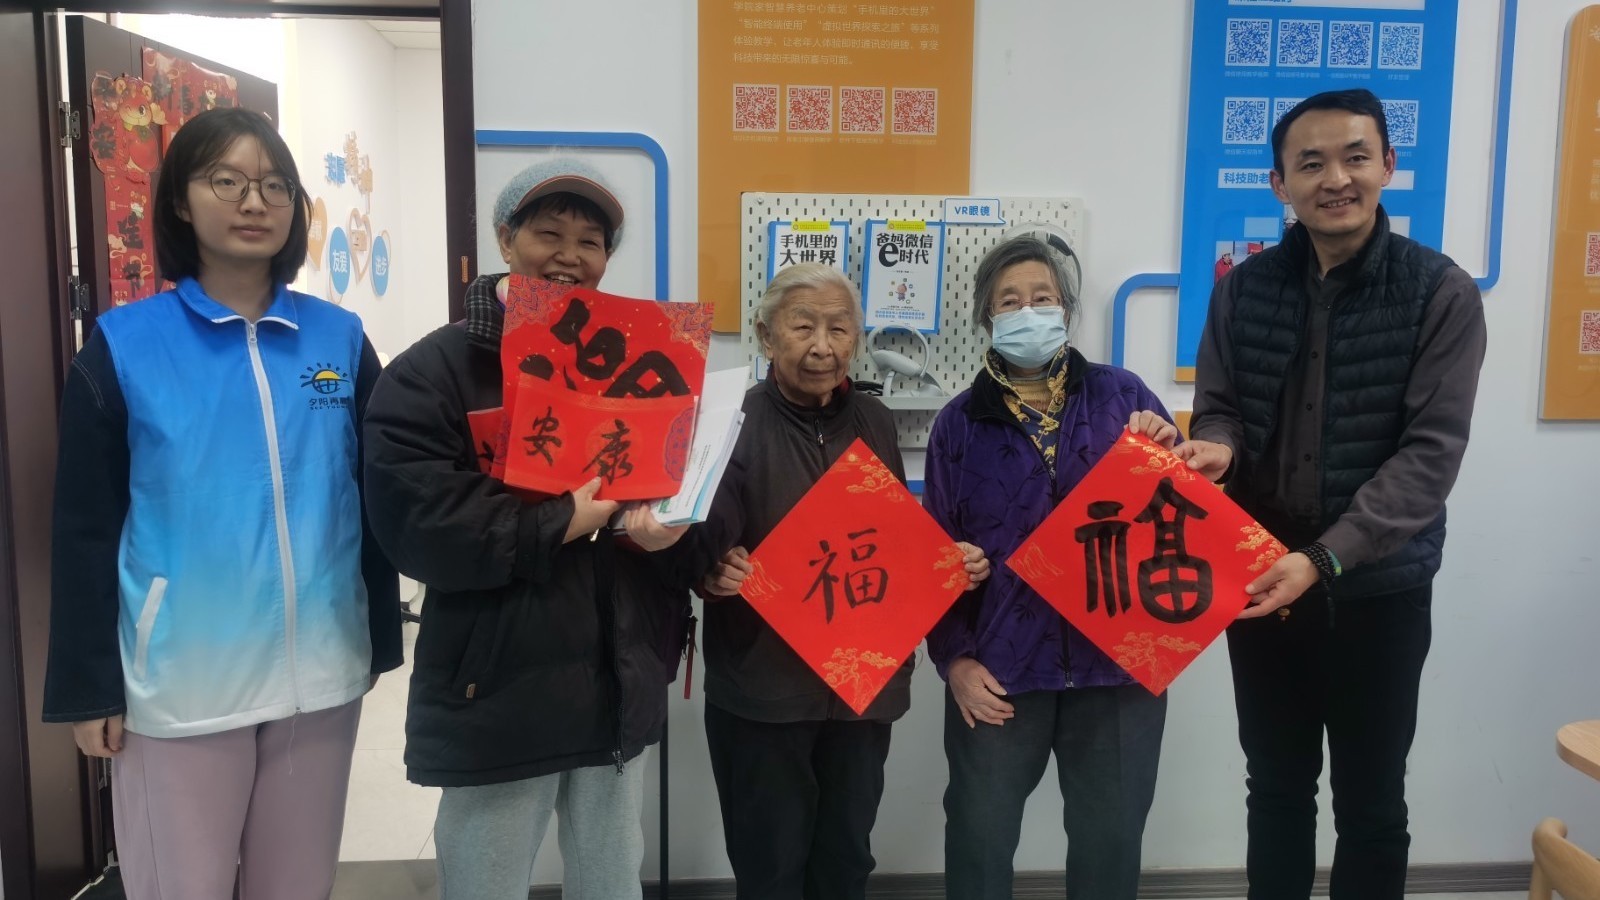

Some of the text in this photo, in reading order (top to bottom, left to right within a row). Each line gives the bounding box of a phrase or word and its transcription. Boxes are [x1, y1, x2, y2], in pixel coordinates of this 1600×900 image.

[954, 205, 991, 217] VR眼镜
[780, 234, 837, 249] 手机里的
[876, 233, 933, 249] 爸妈微信
[332, 250, 348, 274] 友爱
[779, 249, 836, 267] 大世界
[878, 243, 929, 268] e时代
[522, 405, 634, 486] 安康
[1074, 475, 1214, 624] 福
[802, 526, 890, 625] 福
